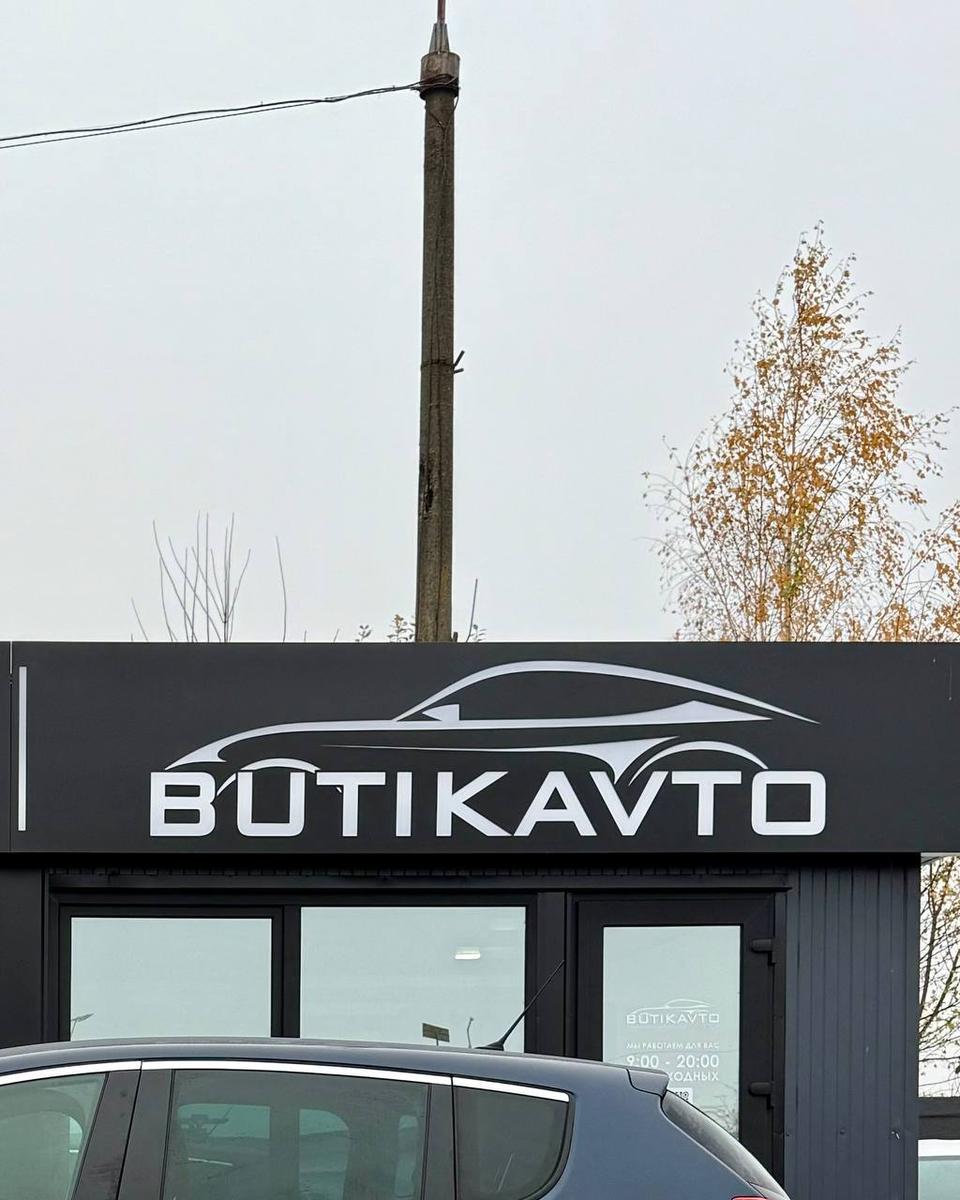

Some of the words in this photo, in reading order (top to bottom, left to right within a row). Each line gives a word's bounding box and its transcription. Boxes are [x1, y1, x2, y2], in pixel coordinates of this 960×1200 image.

[150, 770, 826, 838] BUTIKAVTO
[626, 1013, 720, 1024] BUTIKAVTO
[677, 1054, 720, 1068] 20:00
[668, 1071, 719, 1081] ХОДНЫХ
